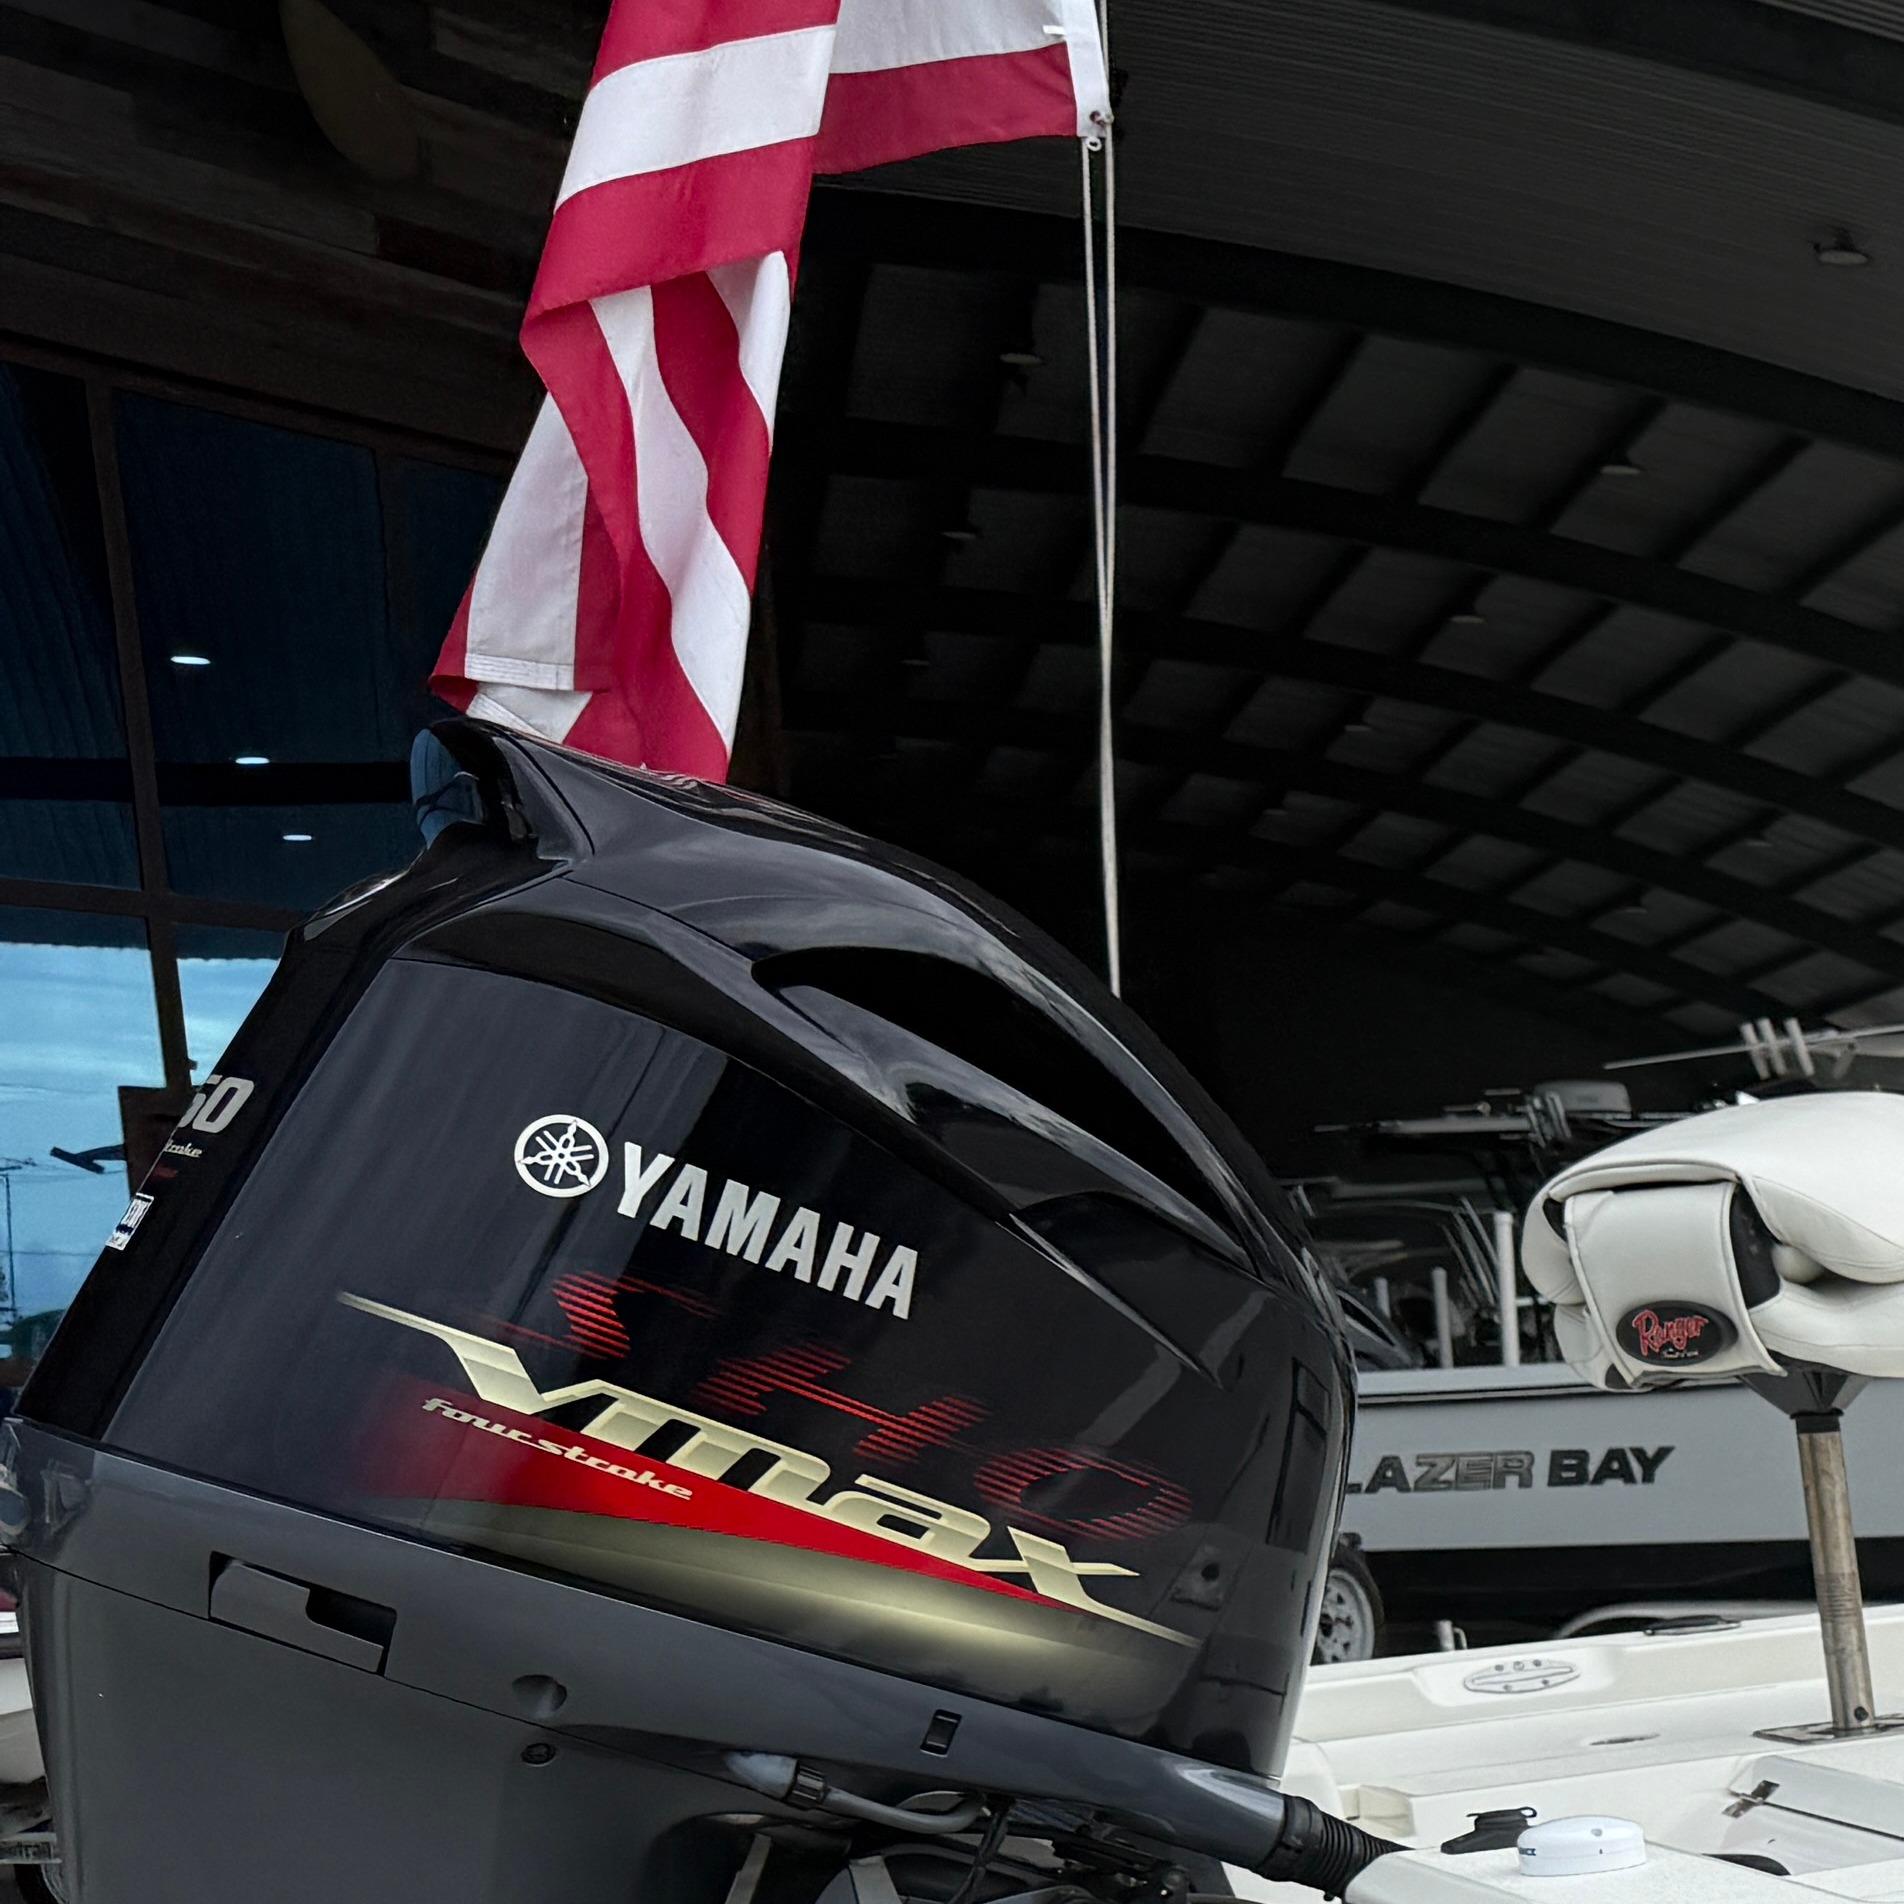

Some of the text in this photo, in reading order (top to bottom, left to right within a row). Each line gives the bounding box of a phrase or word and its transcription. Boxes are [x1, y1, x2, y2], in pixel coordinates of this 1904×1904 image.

[618, 1141, 920, 1320] YAMAHA
[1632, 1309, 1709, 1356] Ranger
[1547, 1446, 1676, 1488] BAY
